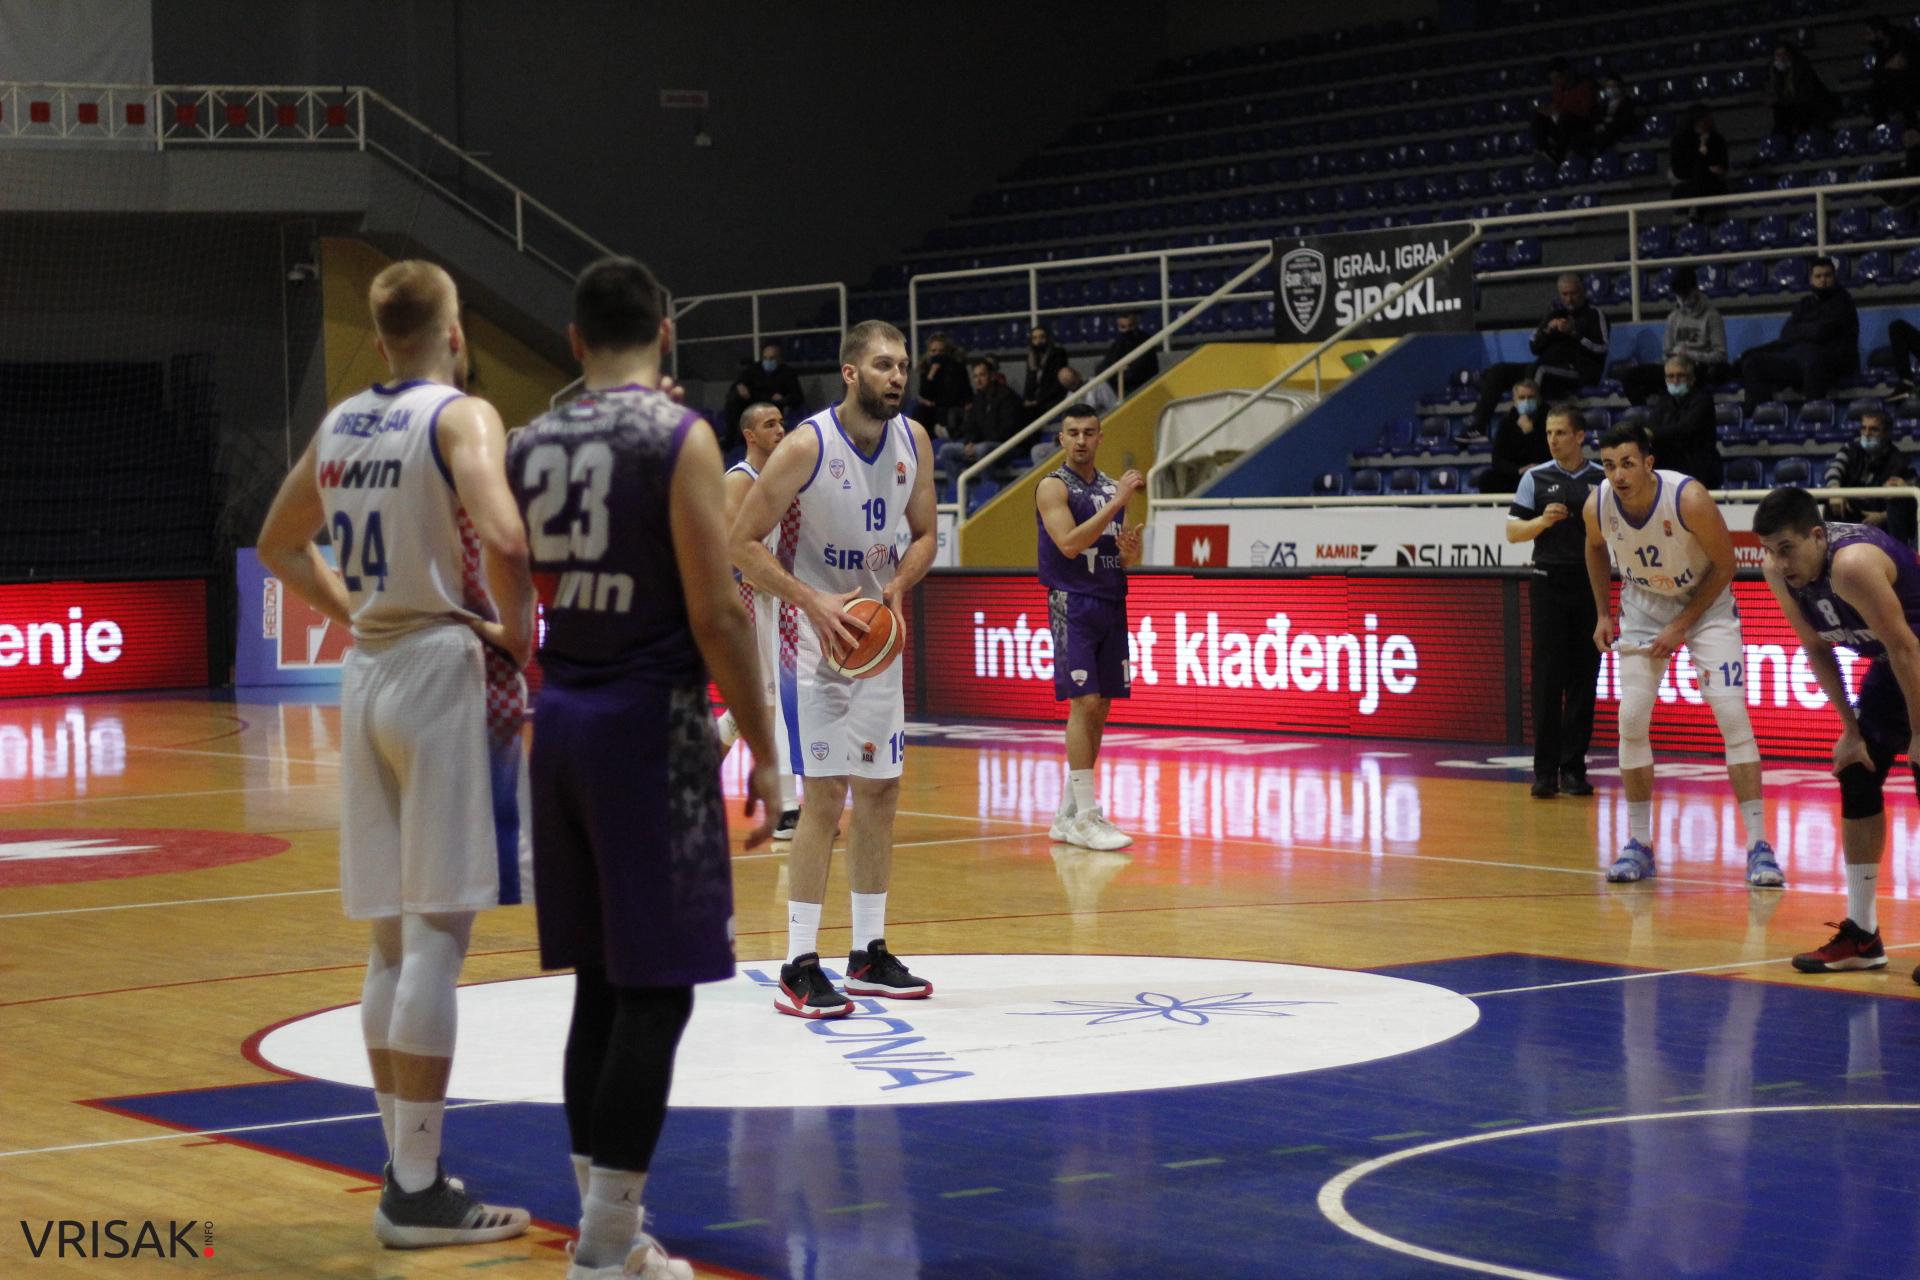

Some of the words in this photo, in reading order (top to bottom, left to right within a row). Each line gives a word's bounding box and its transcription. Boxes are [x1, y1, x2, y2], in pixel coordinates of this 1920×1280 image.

[1333, 250, 1391, 279] IGRAJ,
[522, 441, 614, 563] 23
[861, 497, 886, 532] 19
[333, 510, 388, 592] 24
[1316, 544, 1359, 560] KAMIR
[1634, 545, 1663, 568] 12
[1816, 598, 1841, 627] 8
[1174, 611, 1419, 715] klađenje
[1719, 661, 1744, 687] 12
